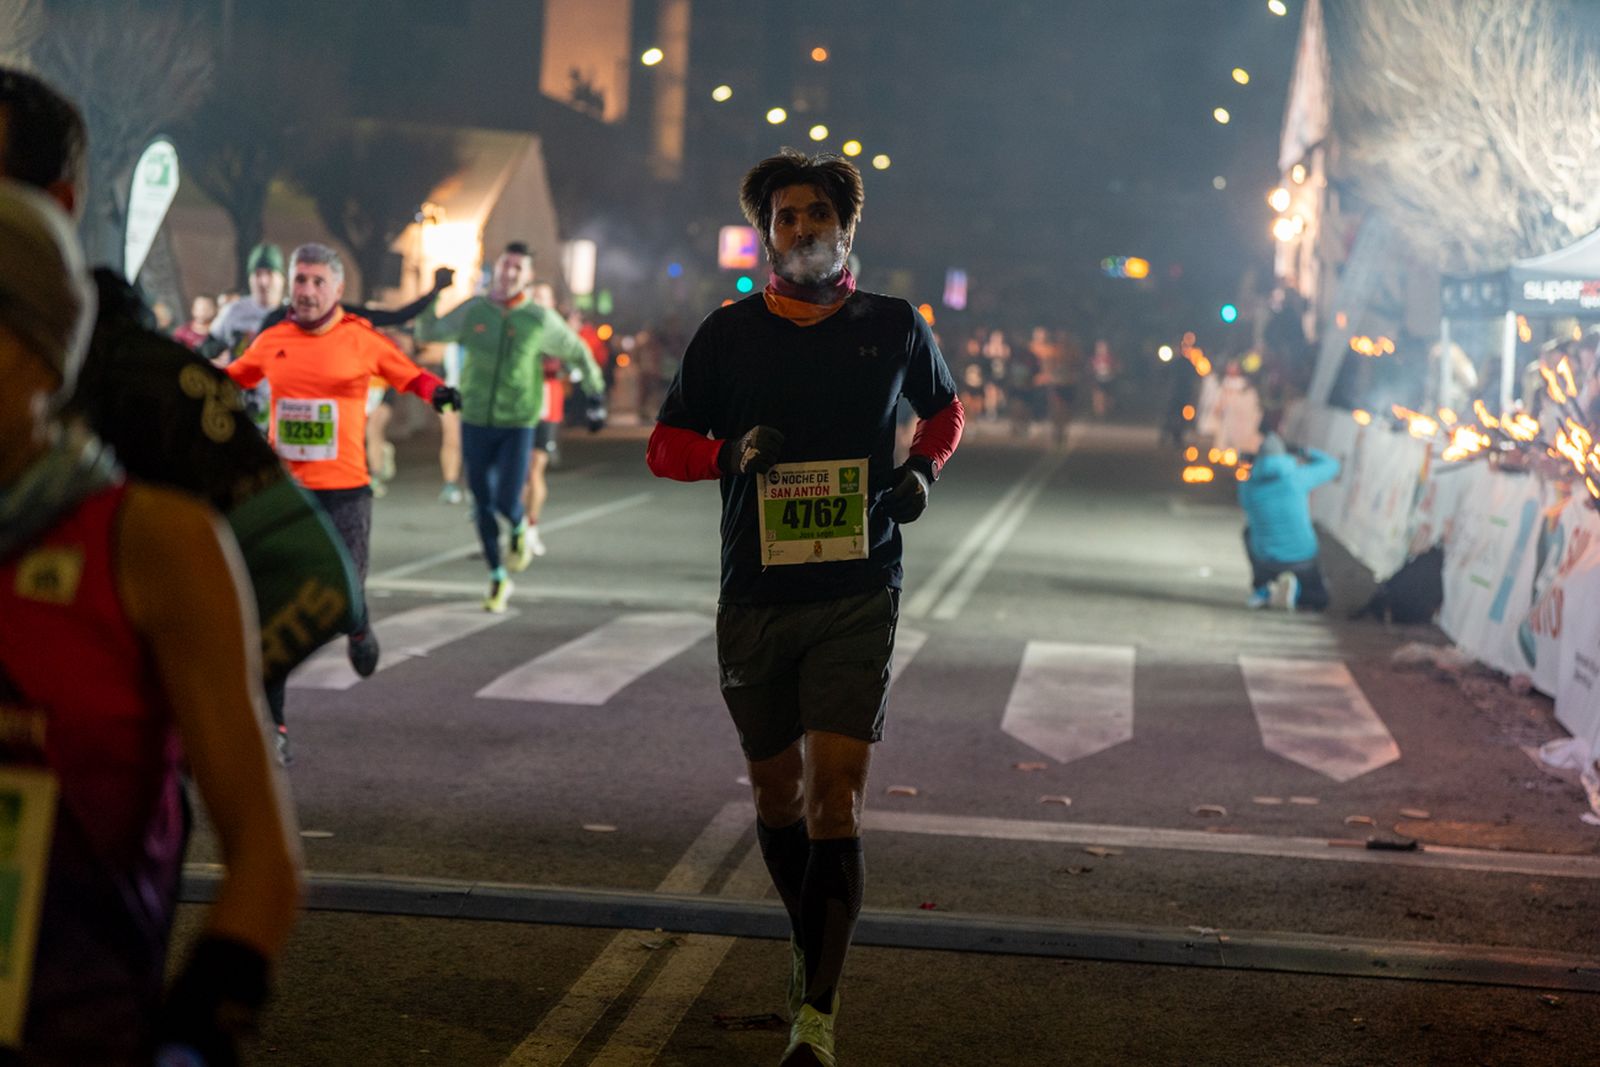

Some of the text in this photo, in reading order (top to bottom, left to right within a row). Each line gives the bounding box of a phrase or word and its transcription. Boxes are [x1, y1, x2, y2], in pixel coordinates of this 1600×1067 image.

[782, 473, 829, 485] NOCHE DE
[771, 488, 792, 499] SAN
[794, 483, 830, 498] ANTÓN
[782, 497, 848, 529] 4762
